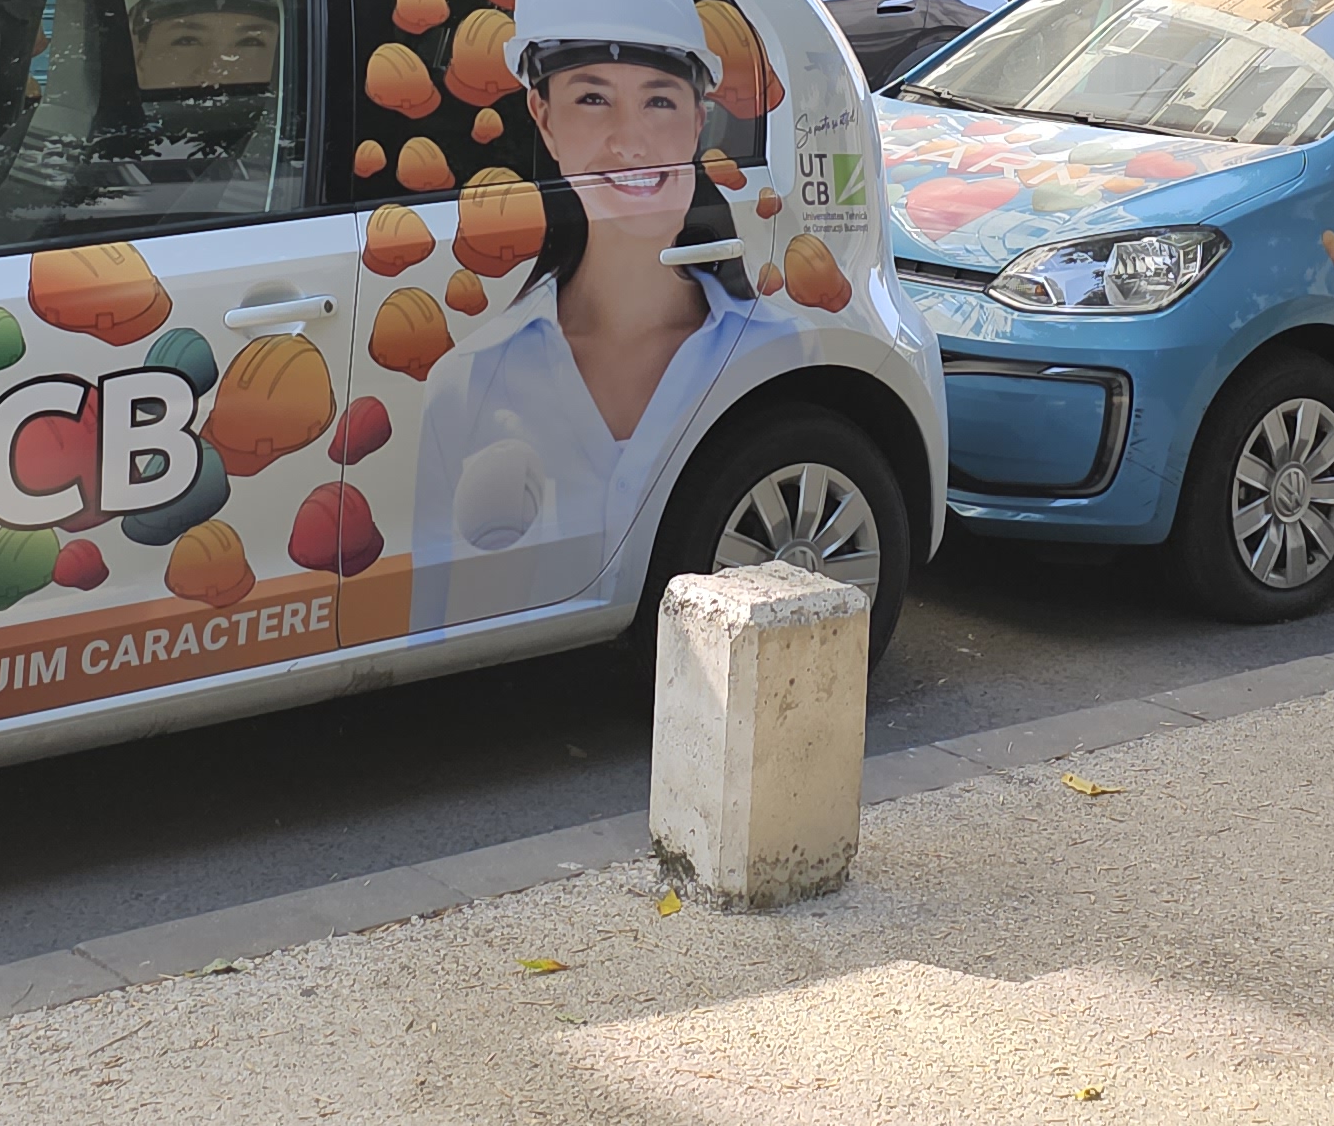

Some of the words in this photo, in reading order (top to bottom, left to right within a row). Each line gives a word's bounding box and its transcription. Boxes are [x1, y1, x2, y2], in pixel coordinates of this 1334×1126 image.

[799, 153, 827, 179] UT
[882, 136, 1115, 196] HARM
[802, 181, 830, 205] CB
[79, 596, 332, 676] CARACTERE
